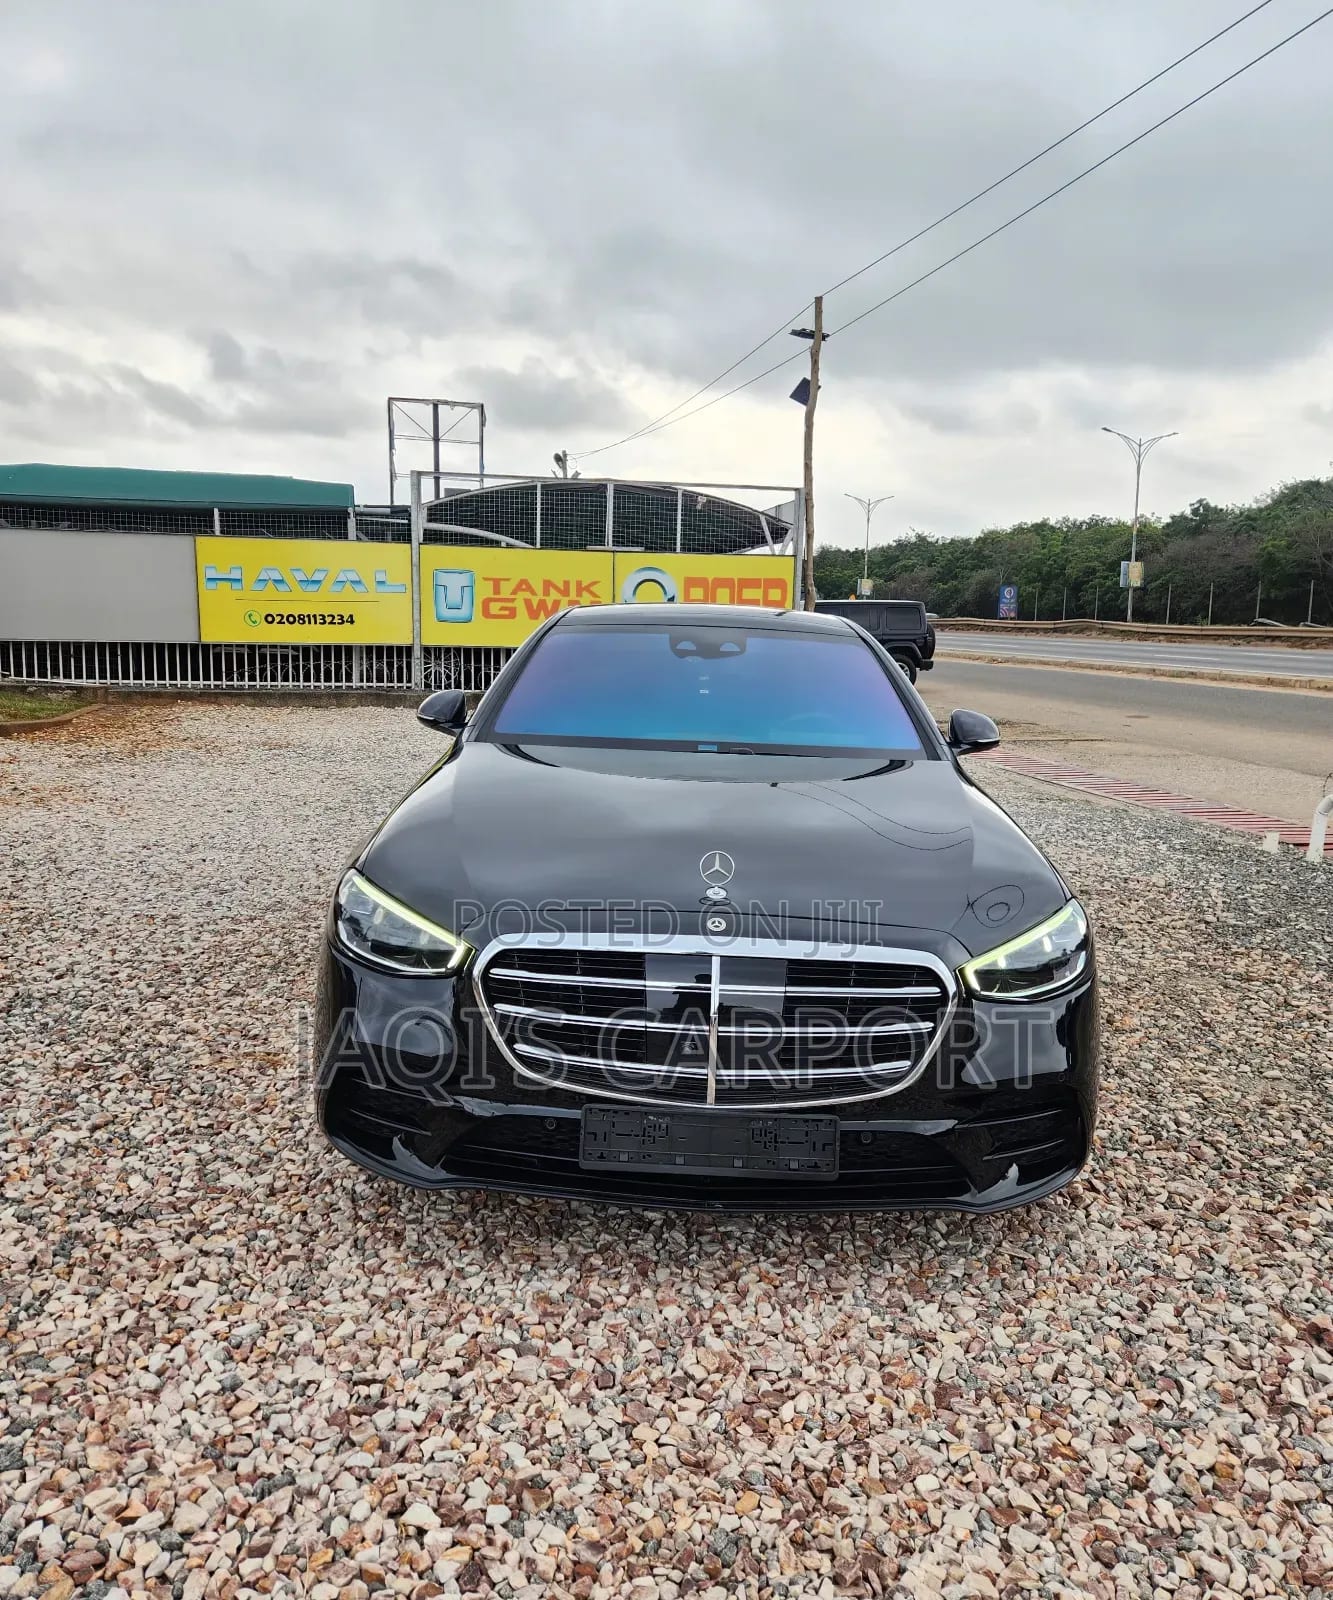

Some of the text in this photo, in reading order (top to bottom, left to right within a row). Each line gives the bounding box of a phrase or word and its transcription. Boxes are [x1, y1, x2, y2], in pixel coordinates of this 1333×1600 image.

[204, 565, 407, 593] HAVAL
[482, 577, 601, 599] TANK
[264, 613, 355, 626] 0208113234
[481, 597, 602, 621] GW
